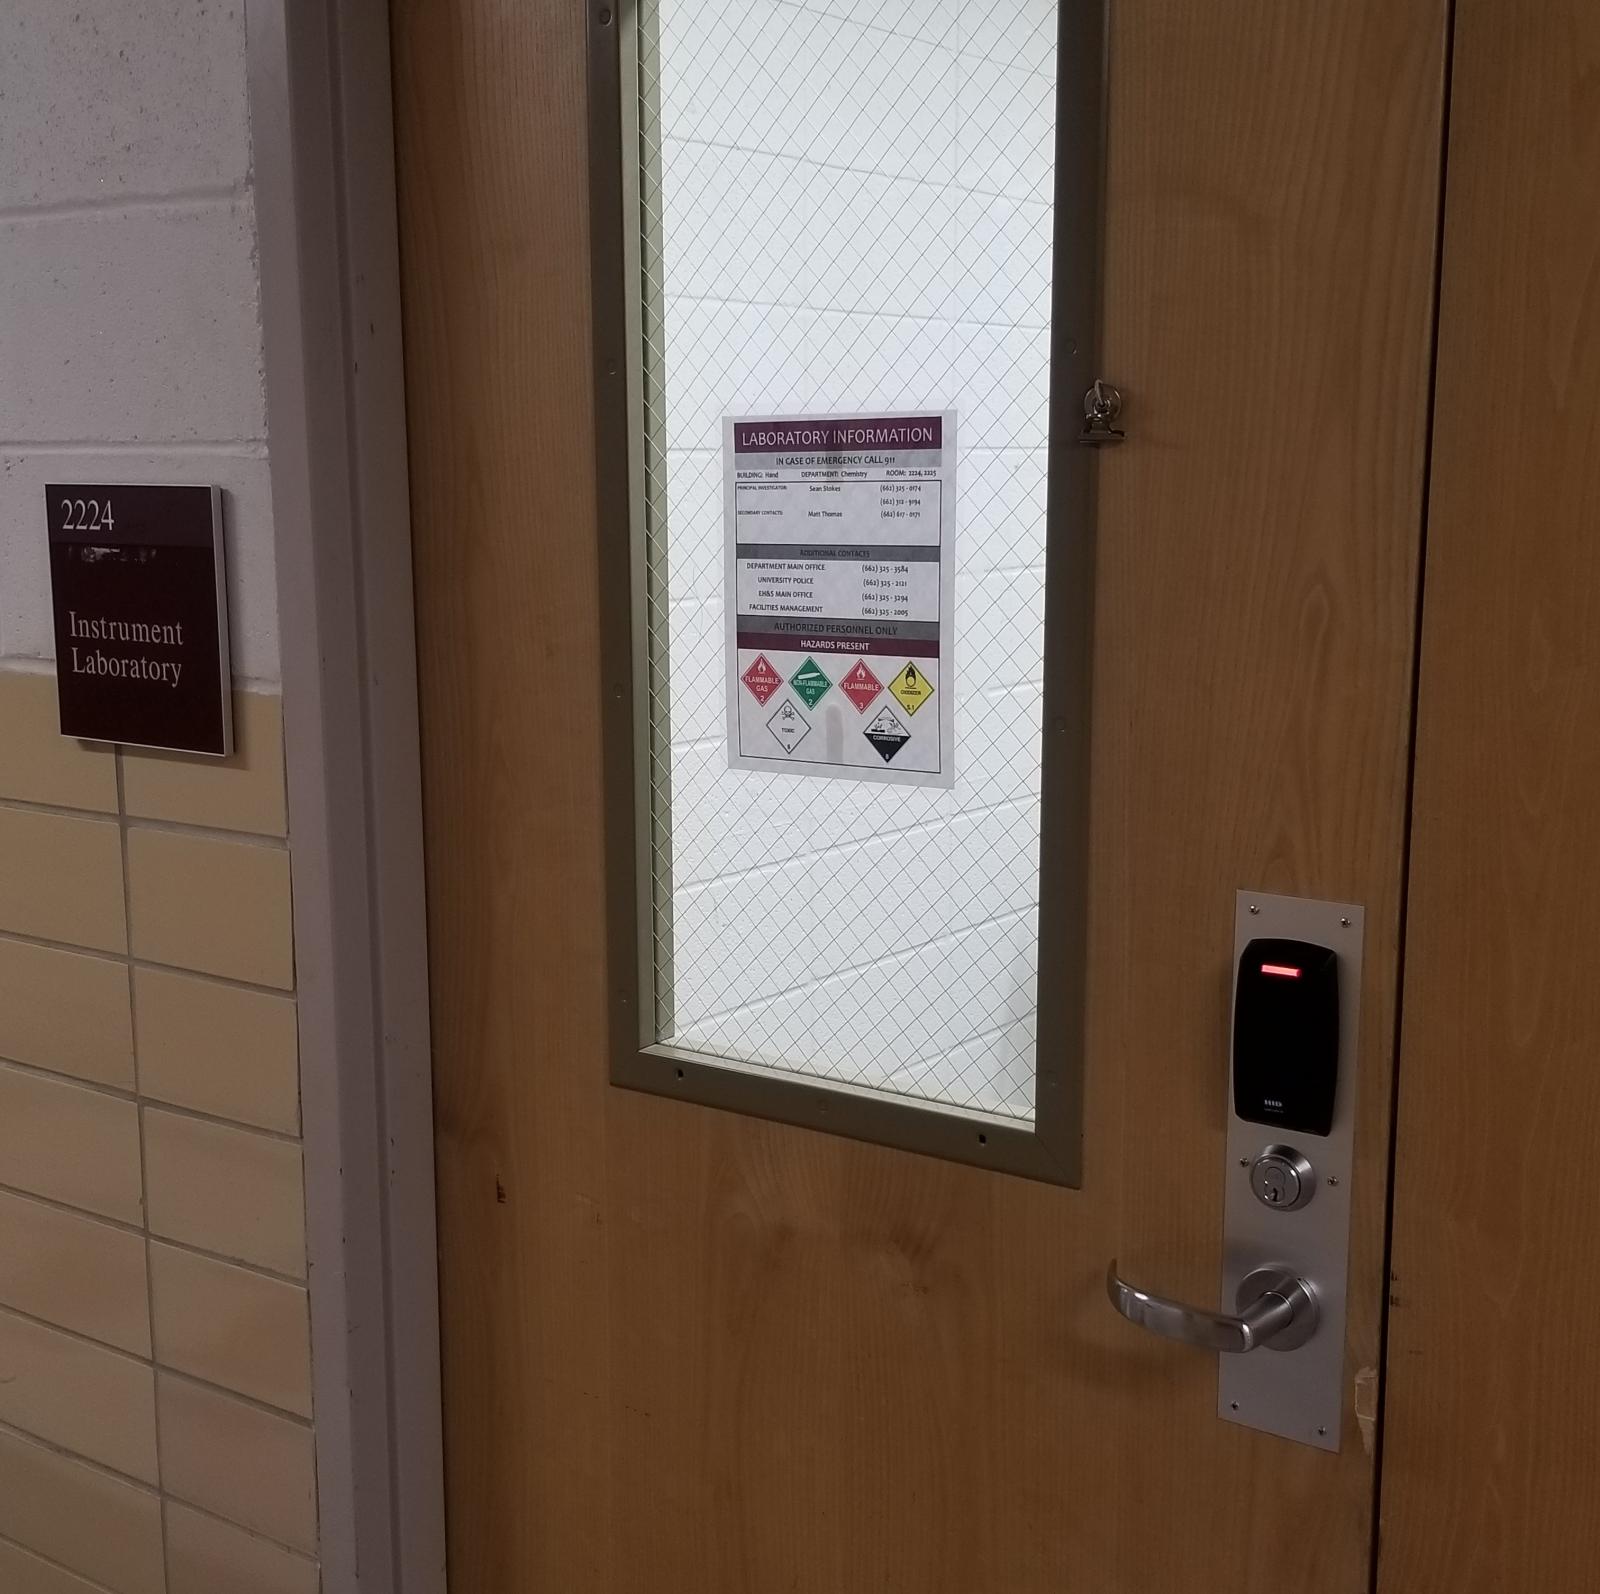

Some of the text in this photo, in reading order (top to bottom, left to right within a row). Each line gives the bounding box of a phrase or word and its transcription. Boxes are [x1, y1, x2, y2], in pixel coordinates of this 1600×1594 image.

[742, 427, 933, 446] LABORATORY INFORMATION
[776, 455, 895, 465] IN CASE OF EMERGENCY CALL 911
[61, 499, 115, 531] 2224
[861, 564, 878, 573] (662)
[894, 565, 908, 573] 3584
[863, 579, 880, 587] (662)
[861, 593, 878, 602] (662)
[749, 603, 779, 611] FACILITIES
[861, 607, 878, 616] (662)
[879, 608, 889, 616] 325
[69, 610, 184, 646] Instrument
[774, 622, 898, 635] AUTHORIZED PERSONNEL ONLY
[800, 640, 870, 650] HAZARDS PRESENT
[71, 646, 182, 689] Laboratory
[745, 676, 779, 685] FLAMMABLE
[843, 682, 879, 691] FLAMMABLE
[808, 698, 813, 706] 2
